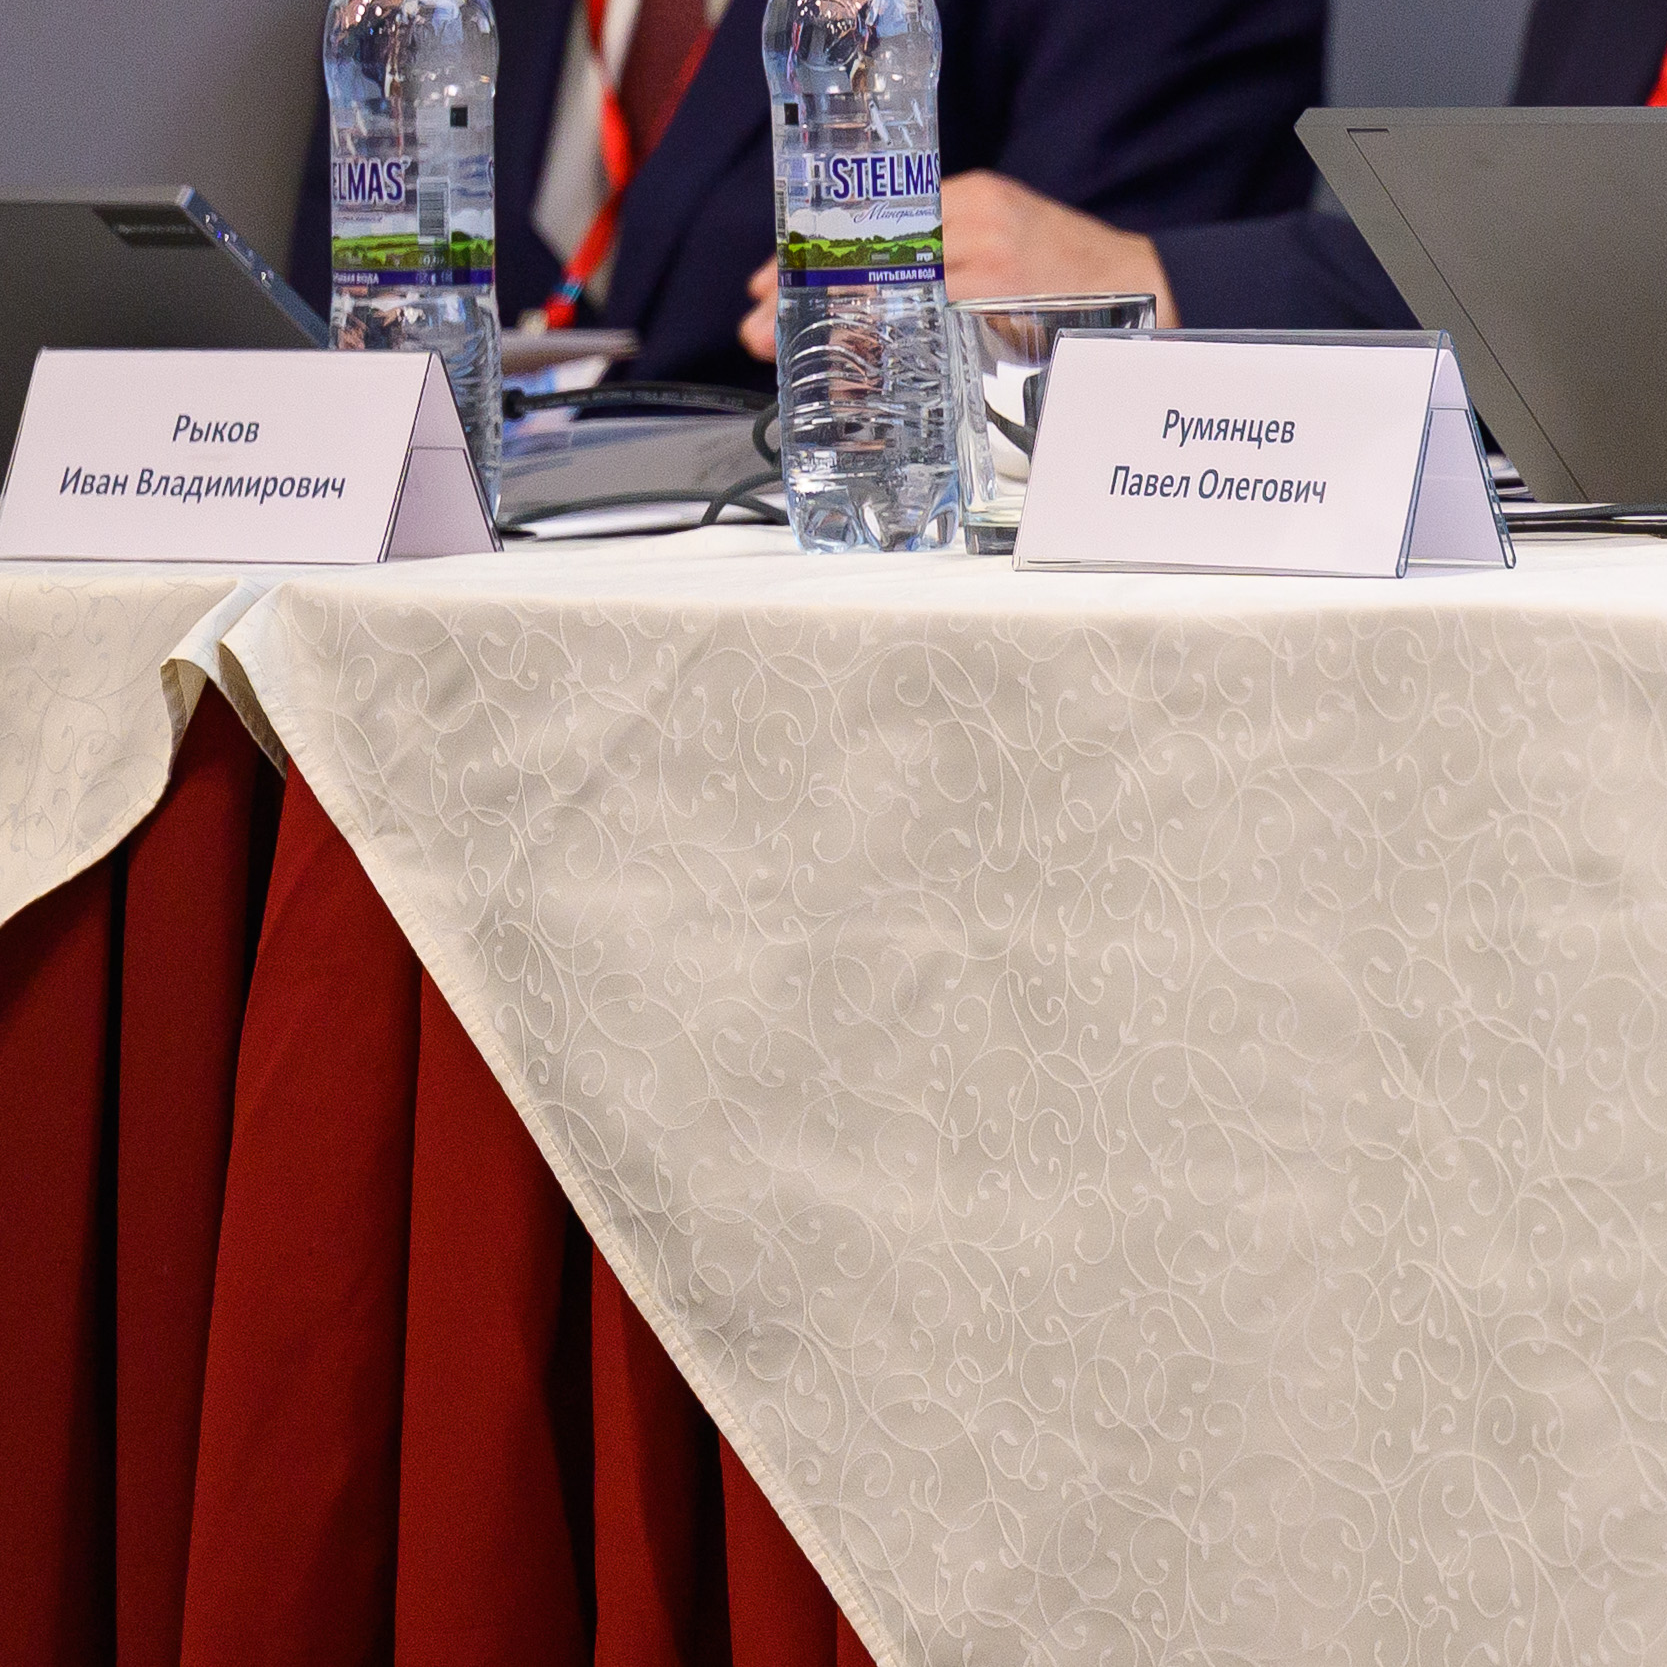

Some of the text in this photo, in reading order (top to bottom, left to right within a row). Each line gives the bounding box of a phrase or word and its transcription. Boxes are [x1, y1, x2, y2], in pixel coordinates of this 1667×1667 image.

[868, 270, 917, 282] ПИТЬЕВАЯ
[171, 414, 260, 444] Рыков
[1161, 409, 1296, 450] Румянцев
[59, 467, 346, 505] Иван Владимирович
[1109, 465, 1327, 504] Павел Олегович
